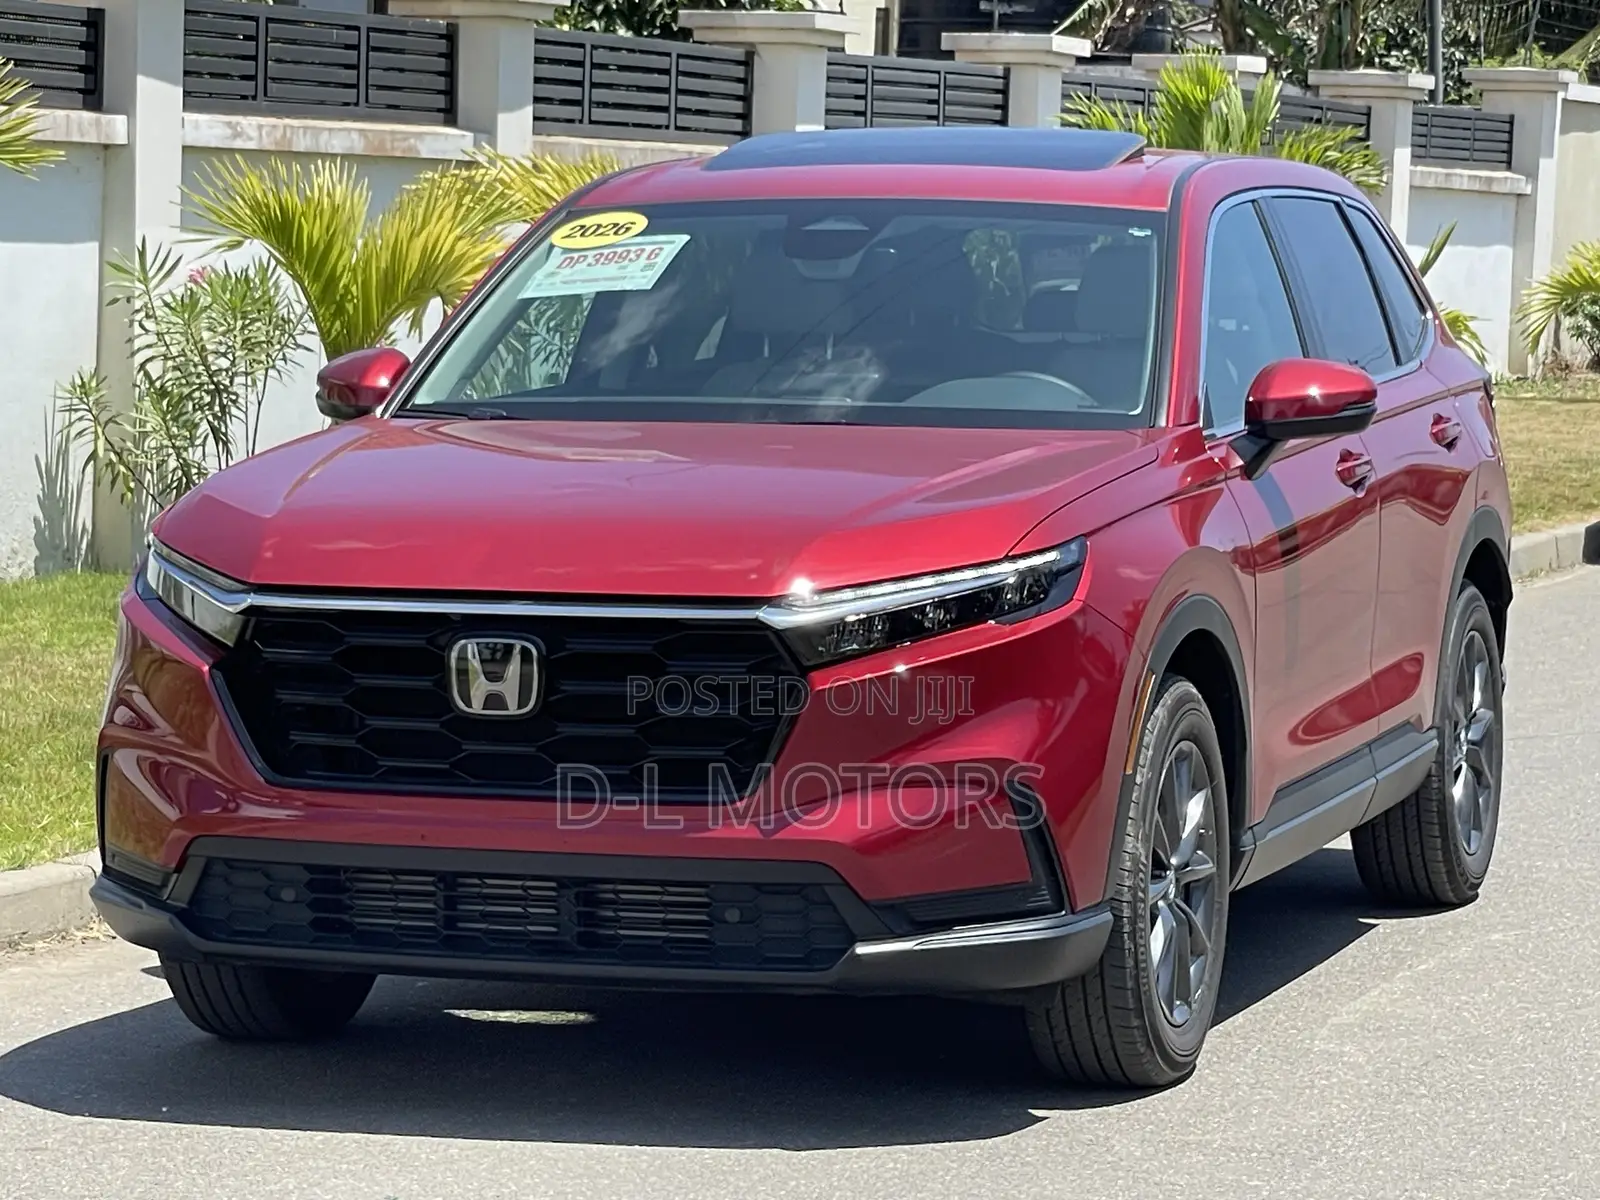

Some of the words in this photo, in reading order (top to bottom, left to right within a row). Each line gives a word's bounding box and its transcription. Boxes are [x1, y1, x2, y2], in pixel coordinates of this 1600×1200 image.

[560, 221, 637, 240] 2026
[556, 254, 589, 269] DP
[586, 247, 646, 267] 3993
